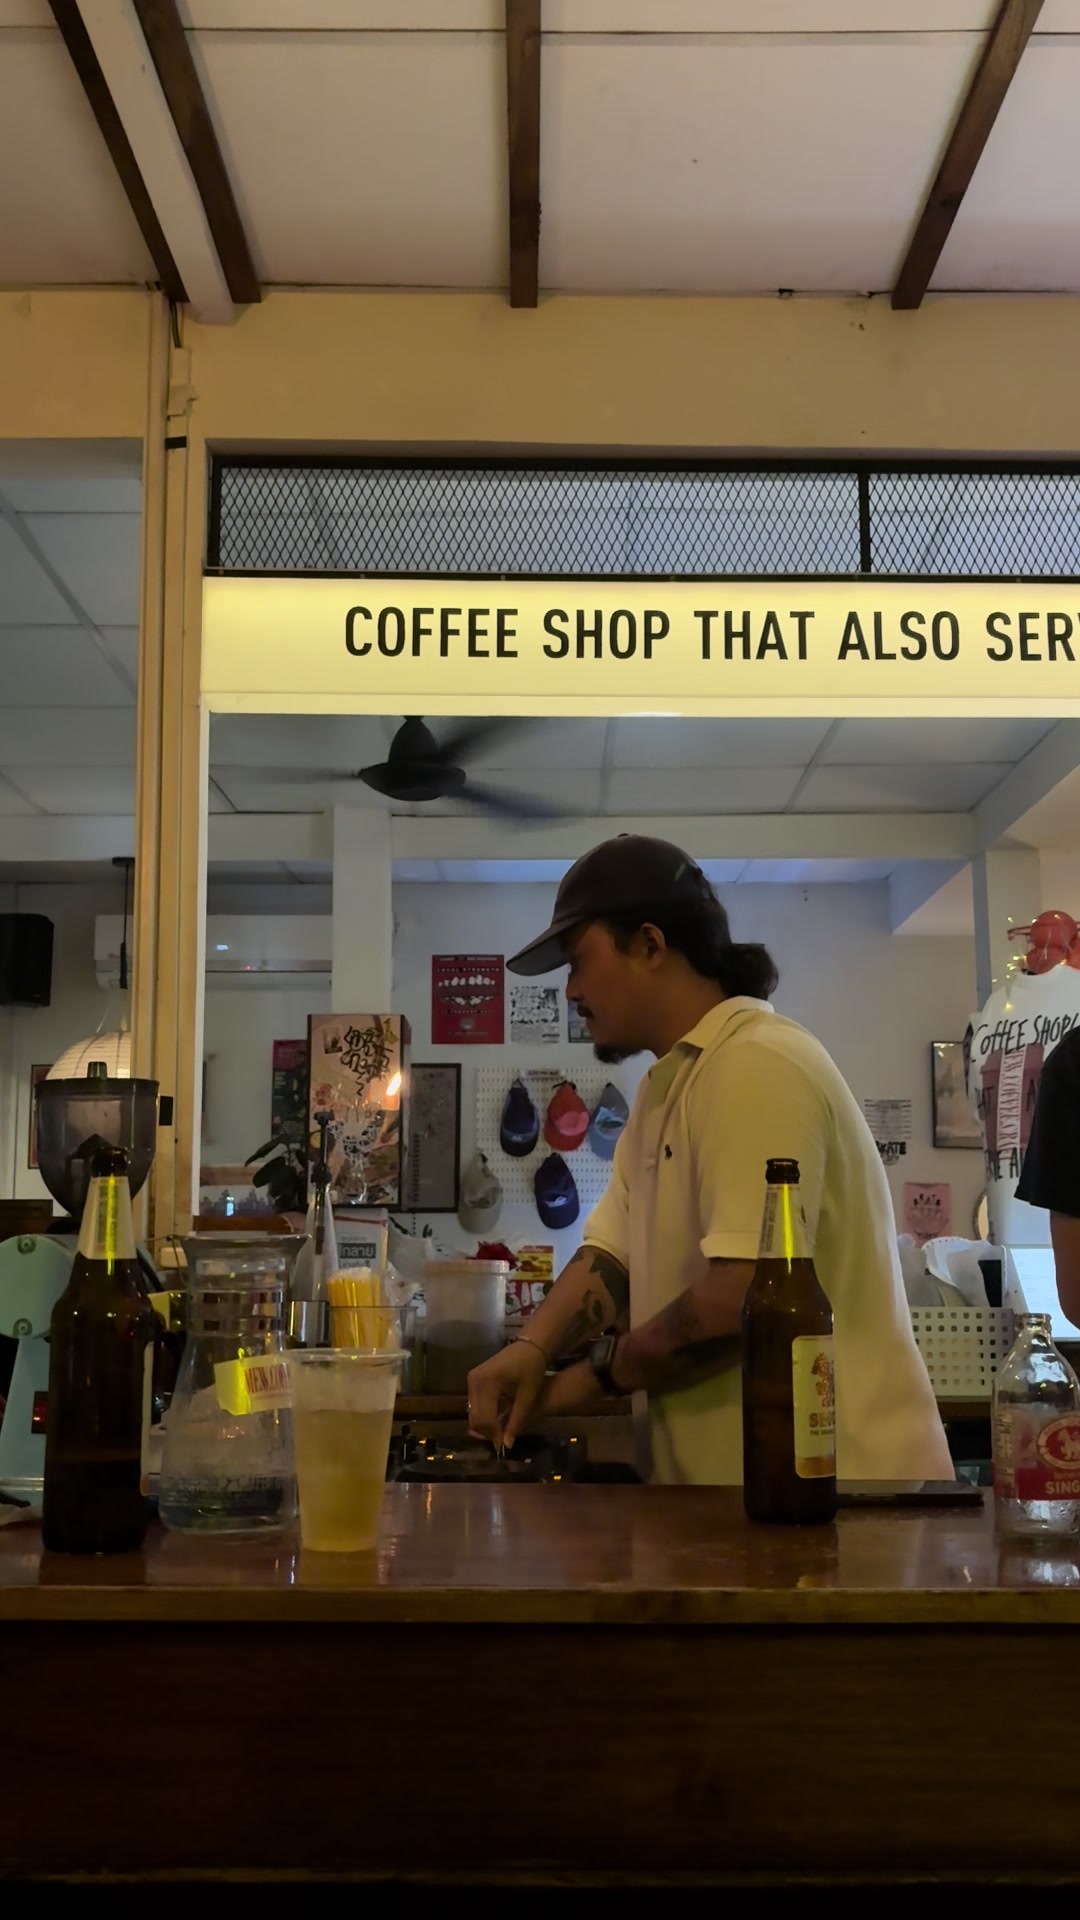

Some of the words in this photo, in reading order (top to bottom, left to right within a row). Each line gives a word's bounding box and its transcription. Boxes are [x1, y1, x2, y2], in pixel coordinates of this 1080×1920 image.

[345, 606, 518, 657] COFFEE
[543, 608, 670, 660] SHOP
[693, 610, 815, 660] THAT
[837, 610, 960, 661] ALSO
[986, 611, 1080, 662] SER
